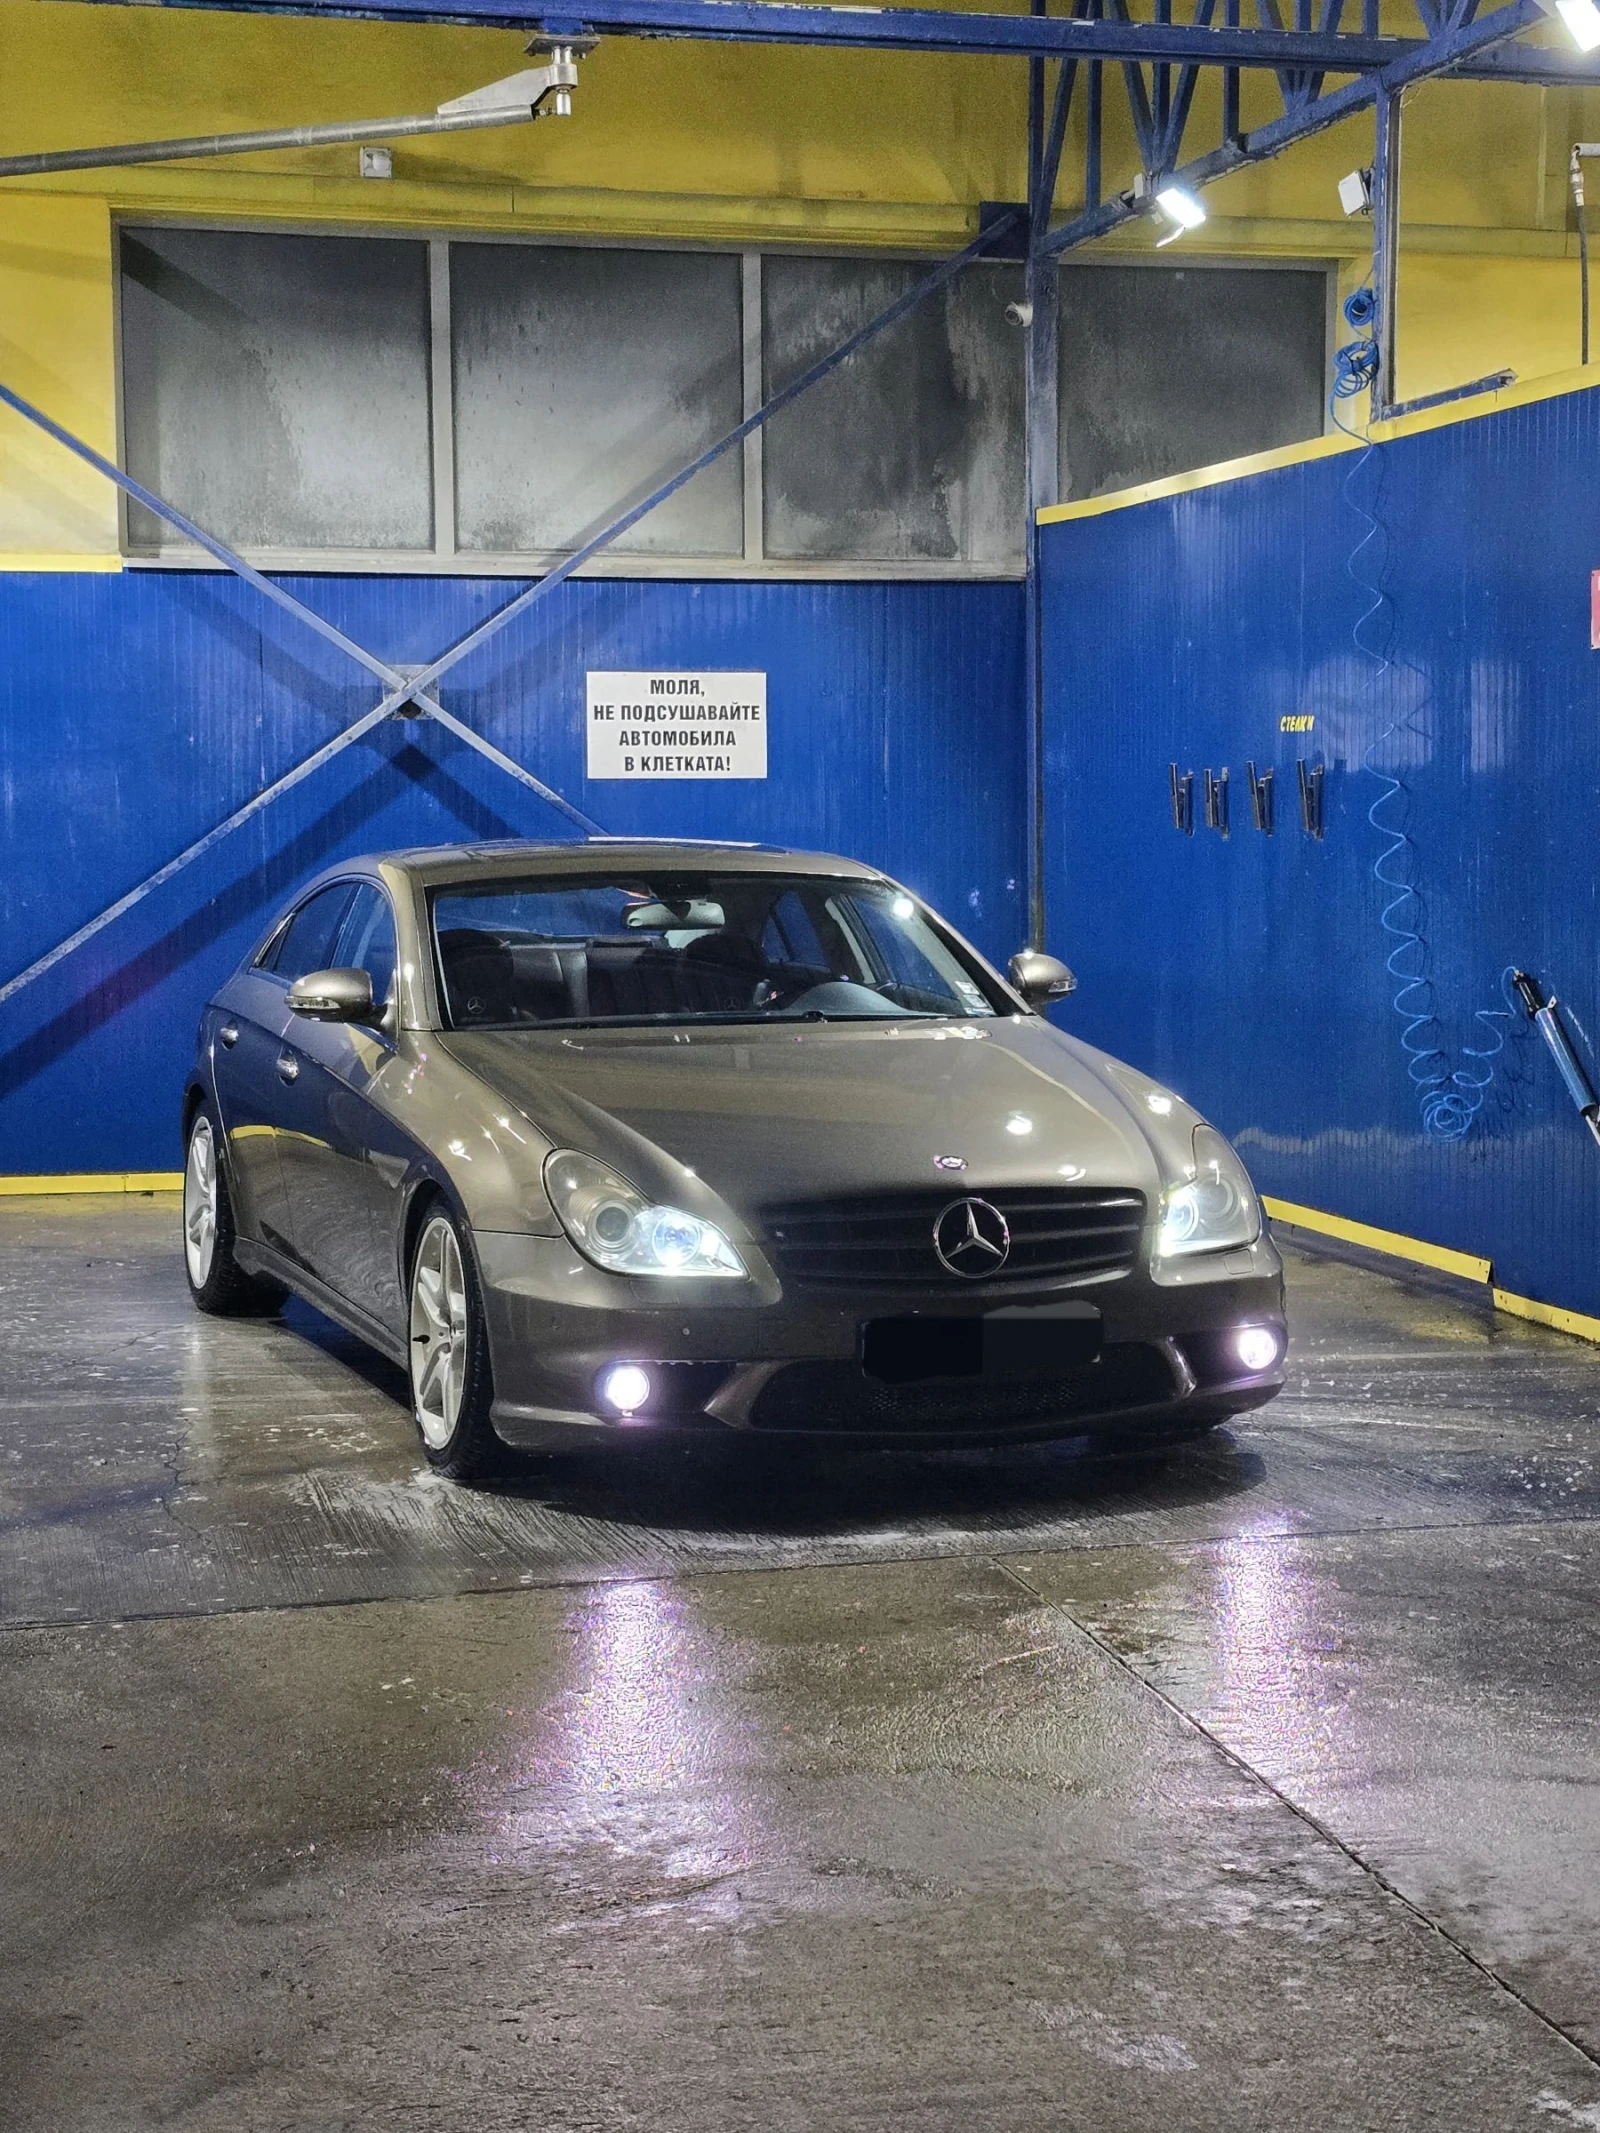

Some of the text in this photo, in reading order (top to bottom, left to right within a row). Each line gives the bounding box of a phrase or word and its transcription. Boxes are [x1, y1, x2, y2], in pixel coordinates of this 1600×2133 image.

[650, 679, 705, 697] МОЛЯ,
[594, 701, 760, 722] НЕ ПОДСУШАВАЙТЕ
[619, 730, 737, 746] АВТОМОБИЛА
[624, 756, 731, 772] В КЛЕТКАТА!
